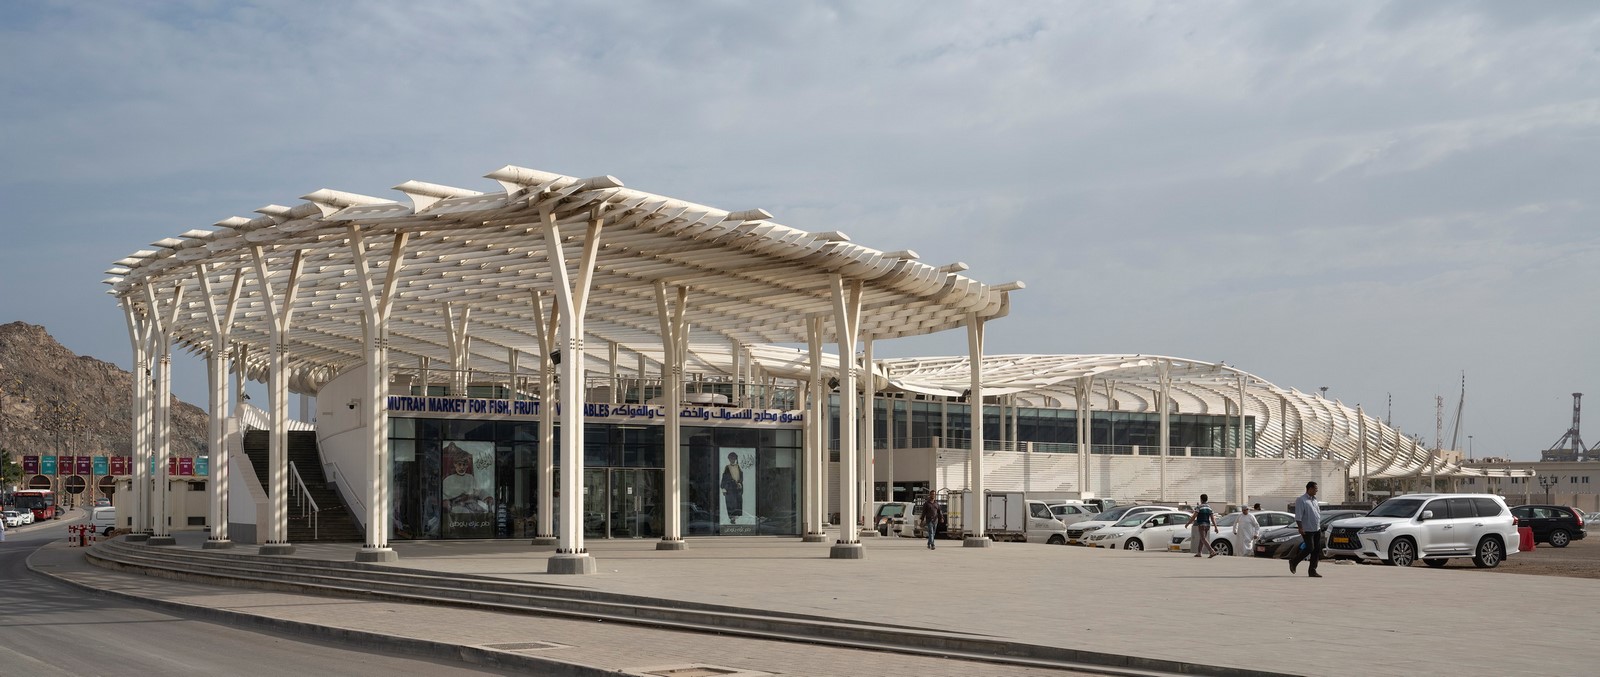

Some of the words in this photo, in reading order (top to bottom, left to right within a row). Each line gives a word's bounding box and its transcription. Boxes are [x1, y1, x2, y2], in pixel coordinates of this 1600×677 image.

[388, 396, 426, 411] MUTRAH
[429, 397, 466, 413] MARKET
[469, 399, 487, 413] FOR
[489, 400, 512, 416] FISH,
[514, 401, 540, 415] FRUIT
[556, 402, 610, 418] VABLES
[754, 409, 778, 422] مطرح
[780, 410, 803, 423] سوق
